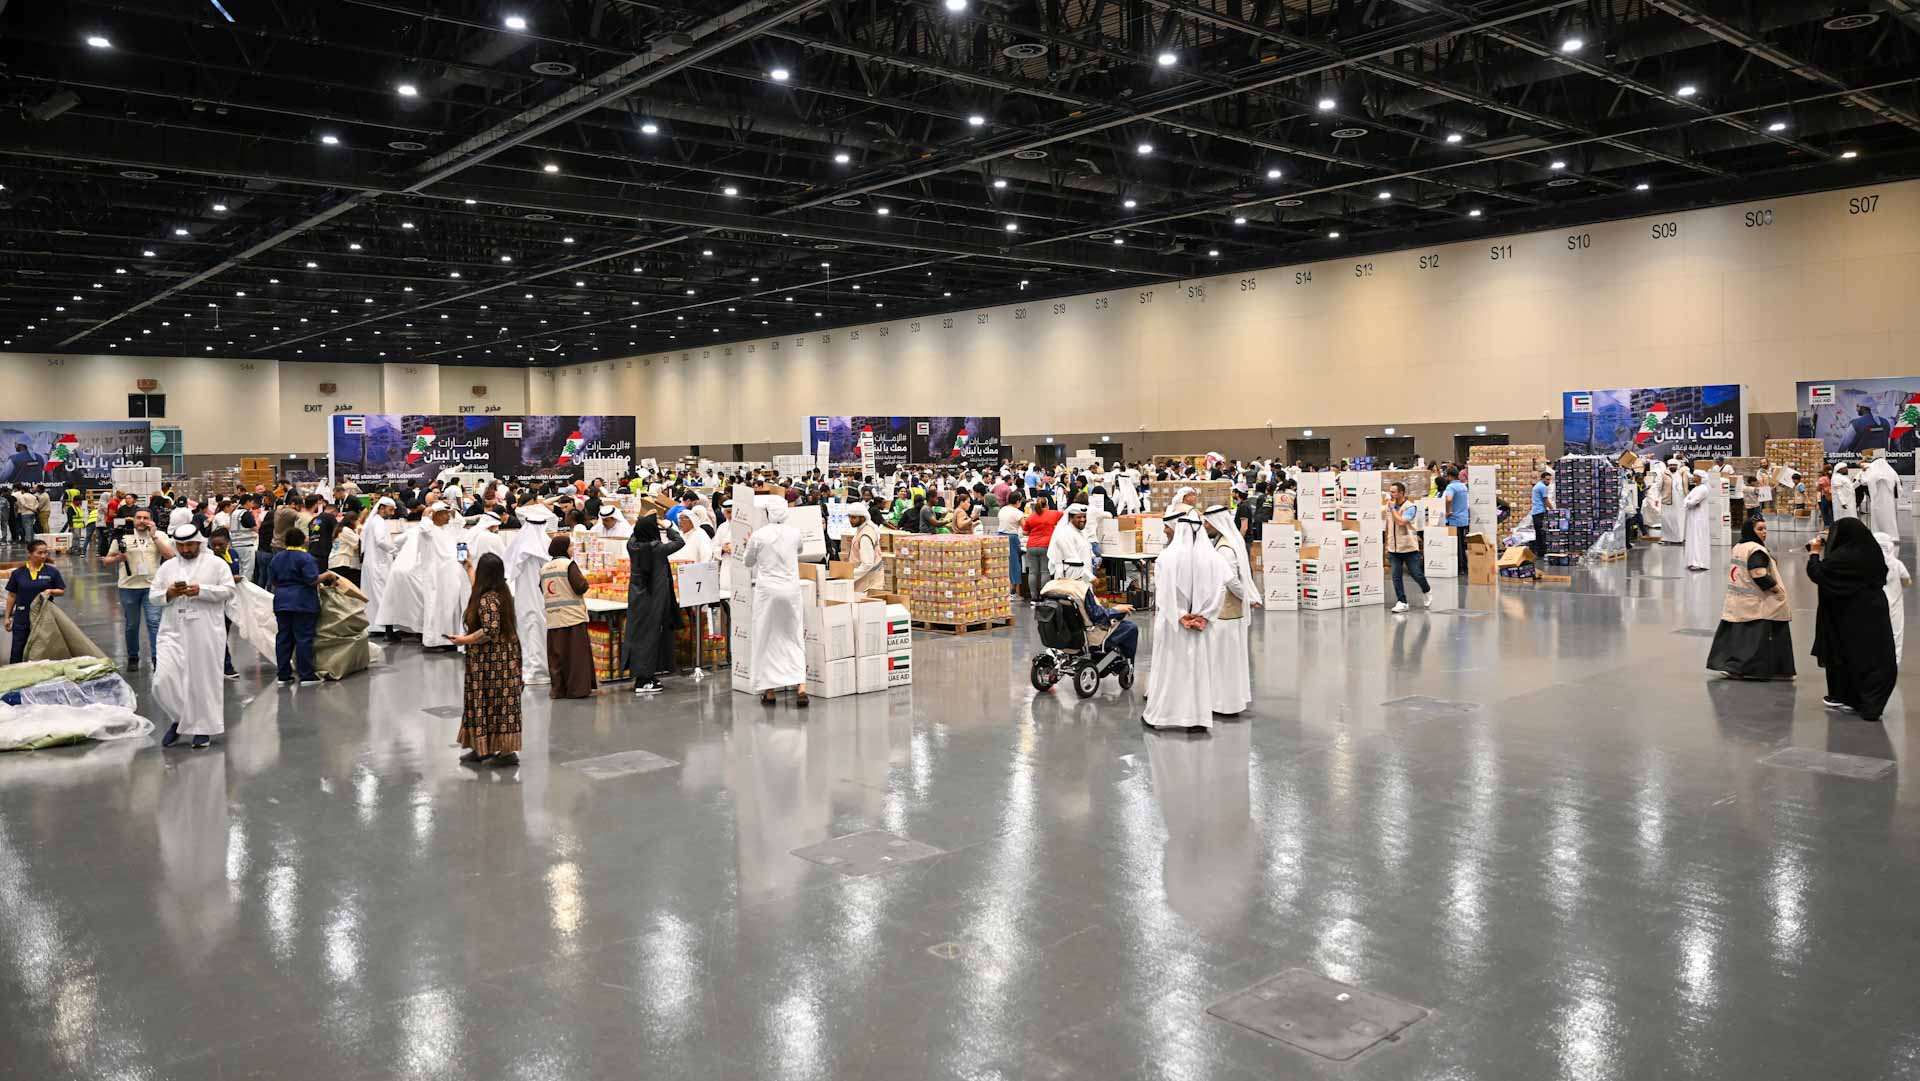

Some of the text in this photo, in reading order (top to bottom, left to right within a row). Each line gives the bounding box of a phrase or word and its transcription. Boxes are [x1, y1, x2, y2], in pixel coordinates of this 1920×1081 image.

[1849, 195, 1879, 215] S07
[1651, 222, 1677, 239] S09
[1567, 233, 1591, 250] S10
[1490, 245, 1512, 260] S11
[1419, 254, 1439, 269] S12
[1355, 263, 1373, 278] S13
[1295, 271, 1312, 285] S14
[1240, 278, 1256, 291] S15
[1140, 292, 1153, 304] S17
[1188, 286, 1203, 298] S16
[1053, 303, 1066, 315] S19
[1095, 297, 1108, 310] S18
[977, 313, 989, 325] S21
[1015, 308, 1027, 320] S20
[304, 404, 322, 413] EXIT
[334, 403, 353, 412] مخرج
[459, 405, 475, 414] EXIT
[485, 404, 501, 413] مخرج
[1653, 427, 1734, 443] معك يا لبنان
[424, 449, 490, 463] معك يا لبنان
[1885, 450, 1914, 458] banon"
[64, 457, 144, 472] معك يا لبنان
[695, 581, 702, 593] 7
[887, 638, 899, 646] UAE
